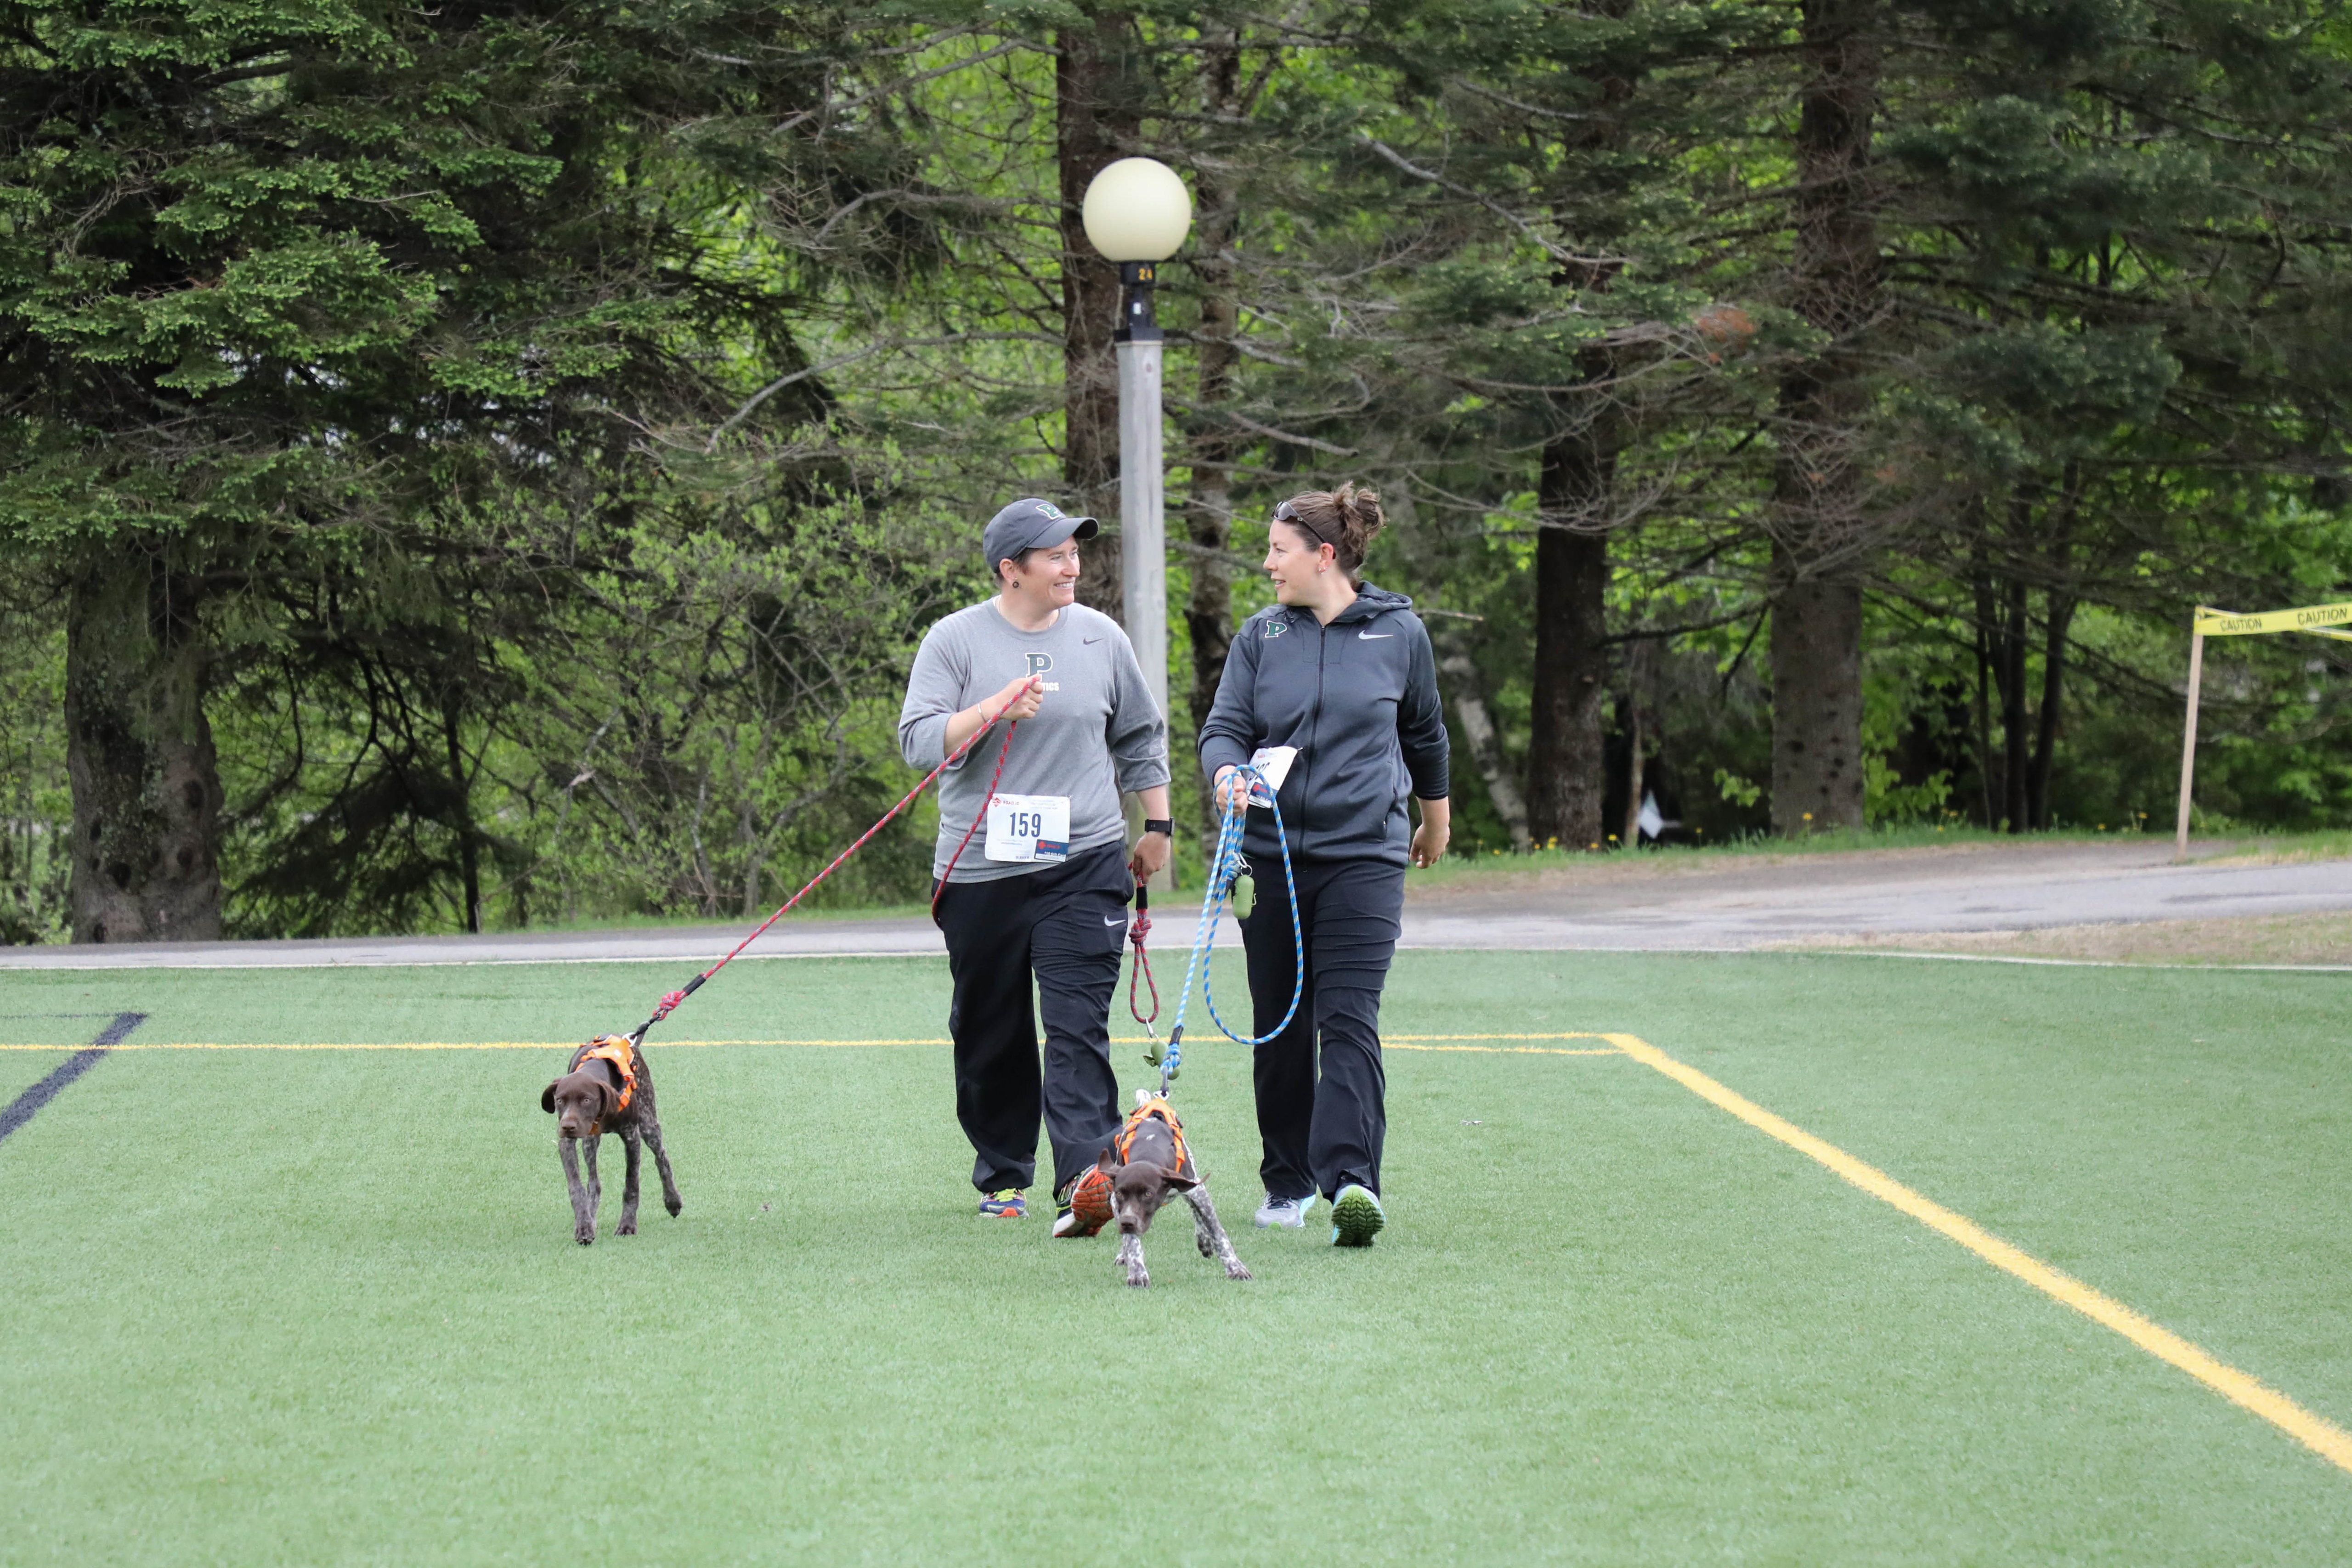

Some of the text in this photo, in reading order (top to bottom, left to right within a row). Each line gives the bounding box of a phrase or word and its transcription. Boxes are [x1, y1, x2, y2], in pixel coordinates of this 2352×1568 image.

[1035, 504, 1061, 520] P
[1265, 620, 1287, 638] P
[2220, 608, 2347, 632] CAUTION CAUTION
[1025, 652, 1053, 682] P
[1010, 812, 1041, 838] 159
